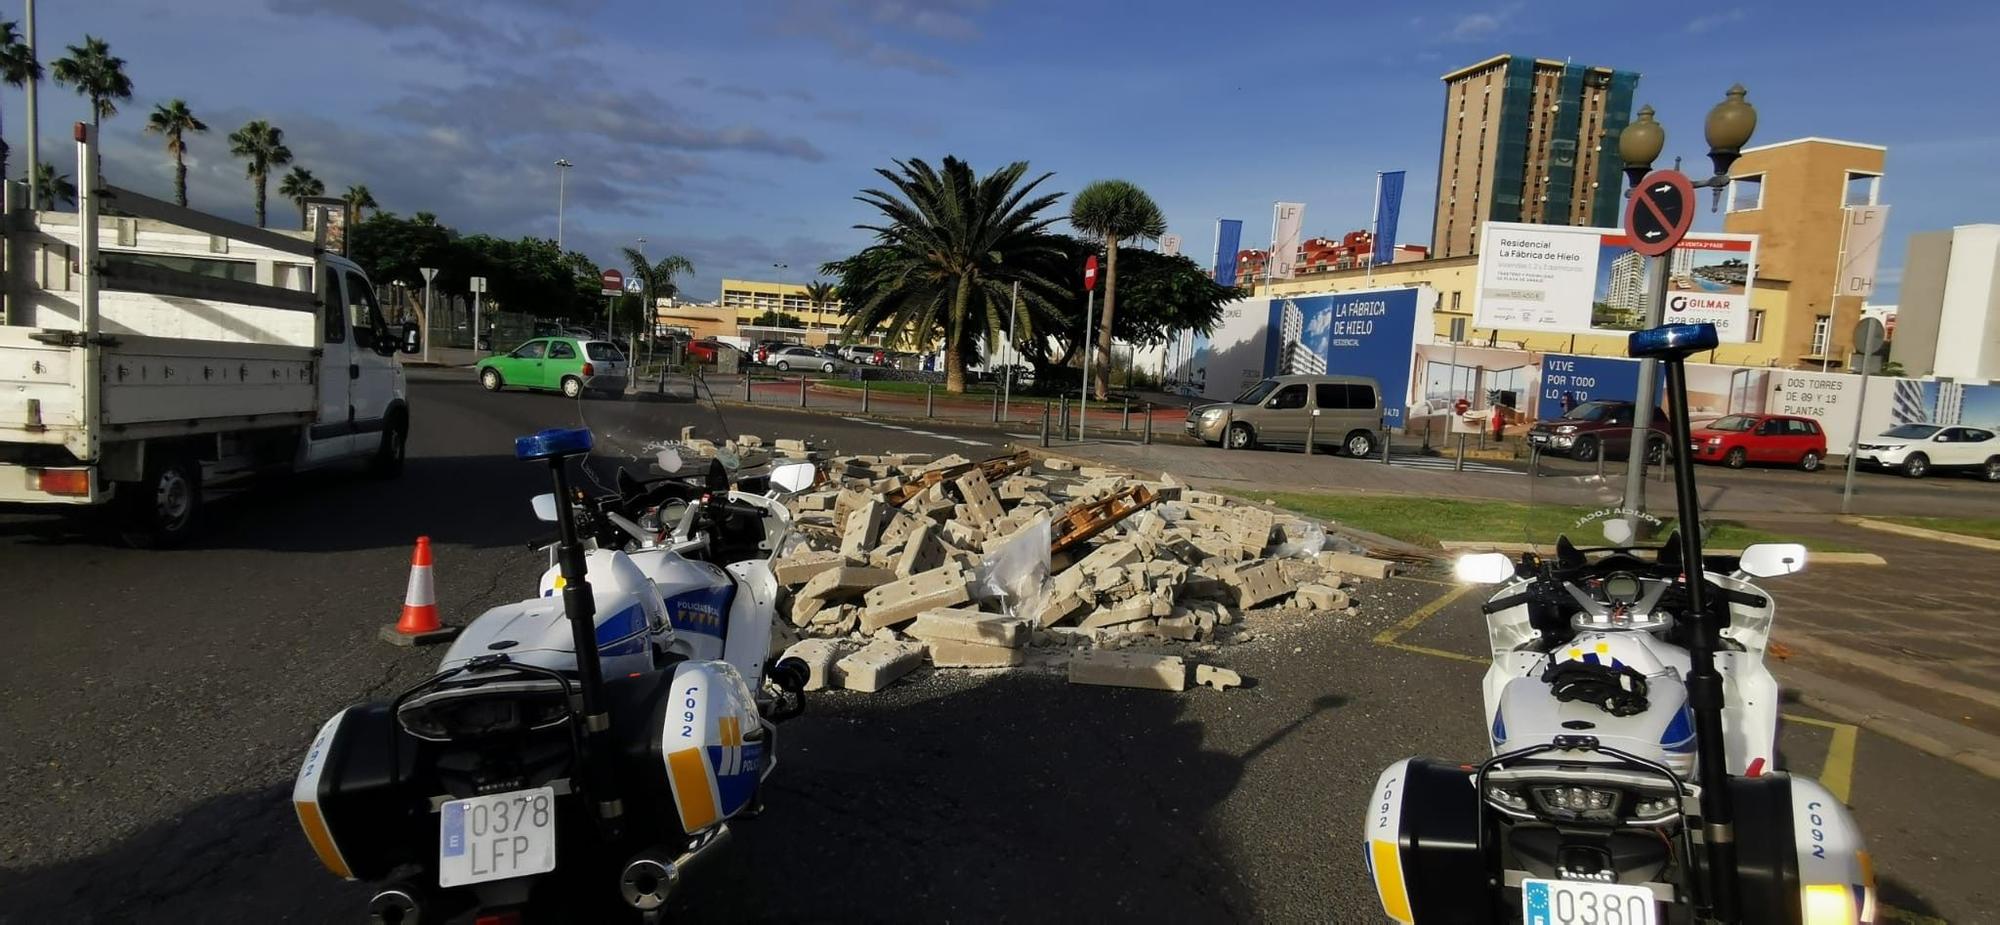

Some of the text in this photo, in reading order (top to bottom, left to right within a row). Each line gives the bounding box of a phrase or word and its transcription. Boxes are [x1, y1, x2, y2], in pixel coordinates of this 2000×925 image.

[1280, 208, 1296, 220] LF
[1853, 210, 1875, 226] LF
[1500, 239, 1551, 249] Residencial
[1500, 249, 1510, 258] La
[1544, 252, 1555, 260] de
[1557, 253, 1580, 261] Hielo
[1336, 299, 1385, 318] LA FÁBRICA
[1689, 299, 1730, 309] GILMAR
[1334, 320, 1373, 335] DE HIELO
[1549, 360, 1575, 372] VIVE
[1547, 374, 1595, 388] POR TODO
[1787, 378, 1843, 391] DOS TORRES
[1545, 389, 1559, 400] LO
[1785, 391, 1798, 402] DE
[1784, 405, 1825, 417] PLANTAS
[472, 795, 549, 837] 0378
[471, 836, 529, 876] LFP
[1556, 889, 1647, 925] 0380
